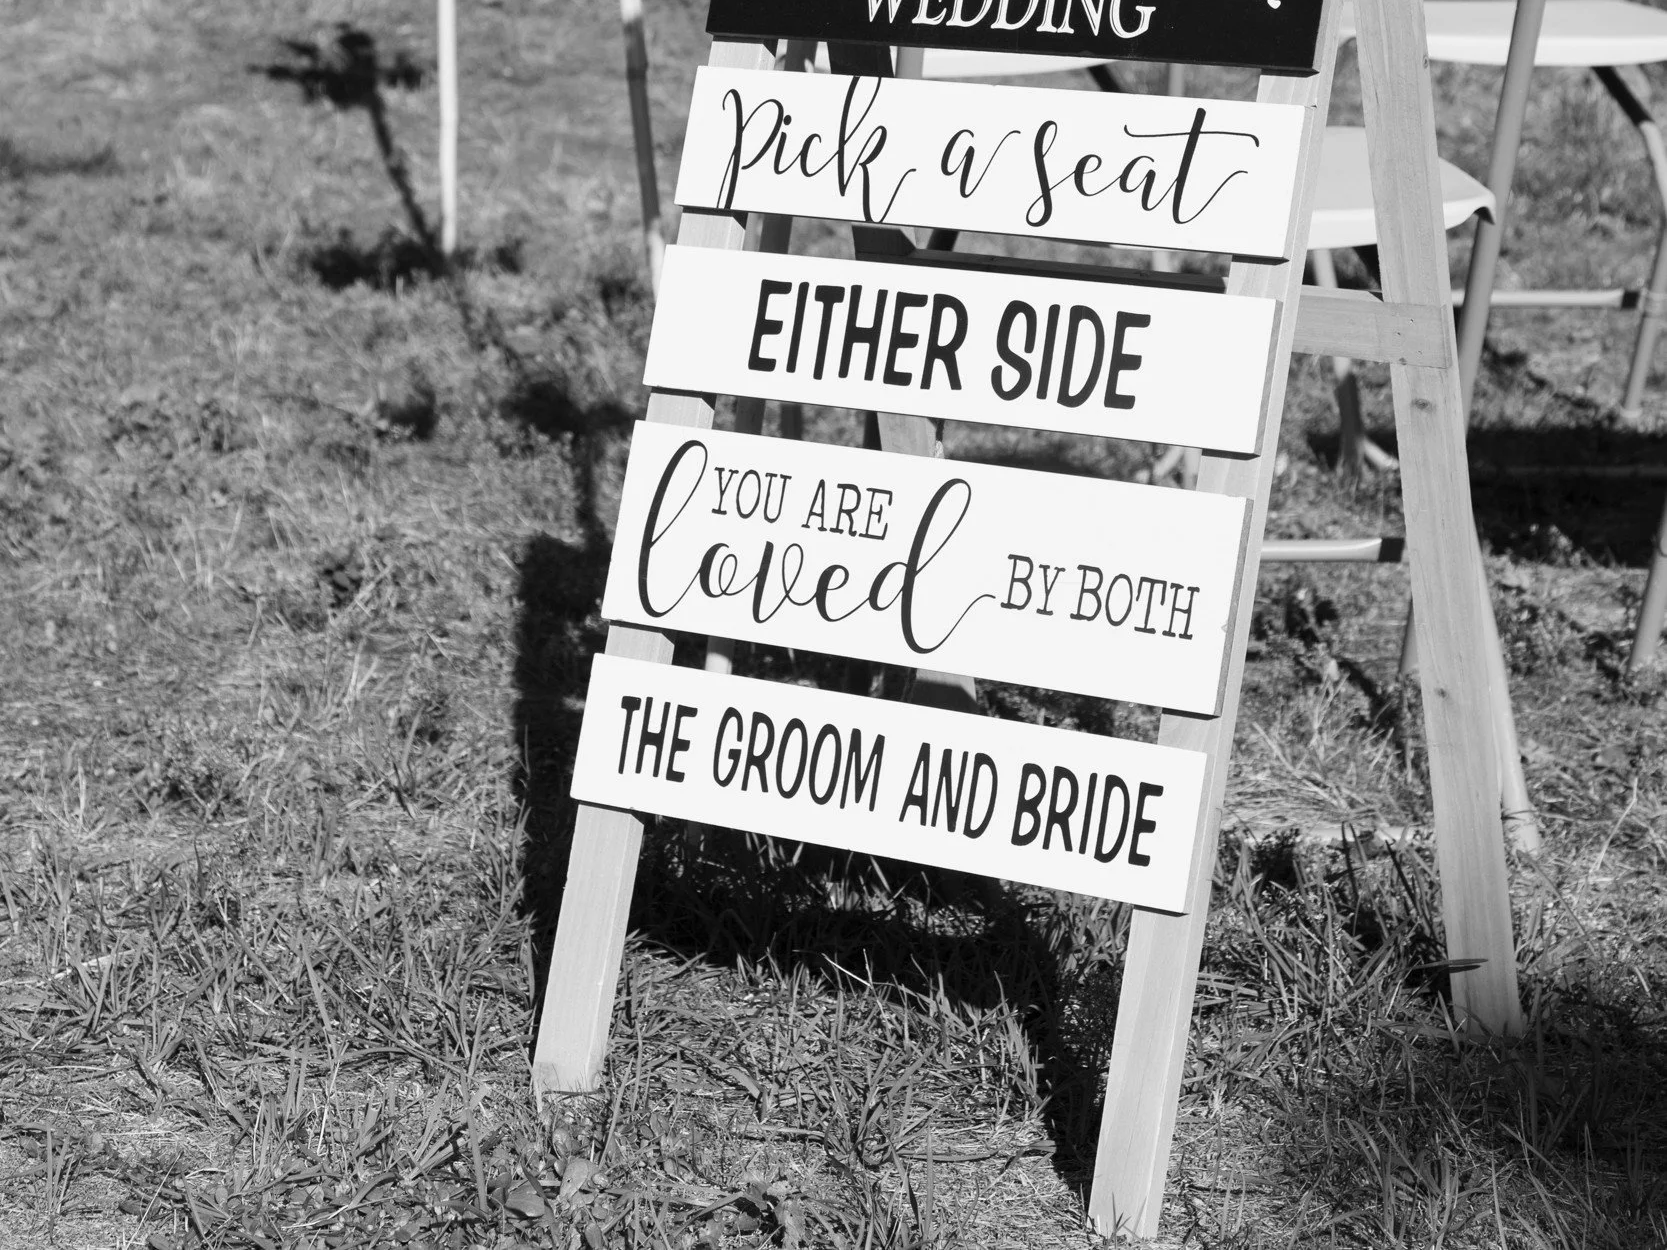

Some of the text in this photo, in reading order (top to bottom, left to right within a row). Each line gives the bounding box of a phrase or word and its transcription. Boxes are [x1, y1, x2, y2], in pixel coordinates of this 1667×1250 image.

[941, 130, 1020, 198] a
[748, 279, 1150, 409] EITHER SIDE
[639, 440, 995, 653] loved
[712, 467, 892, 540] YOU ARE
[1001, 554, 1199, 639] BY BOTH
[619, 696, 1163, 866] THE GROOM AND BRIDE
